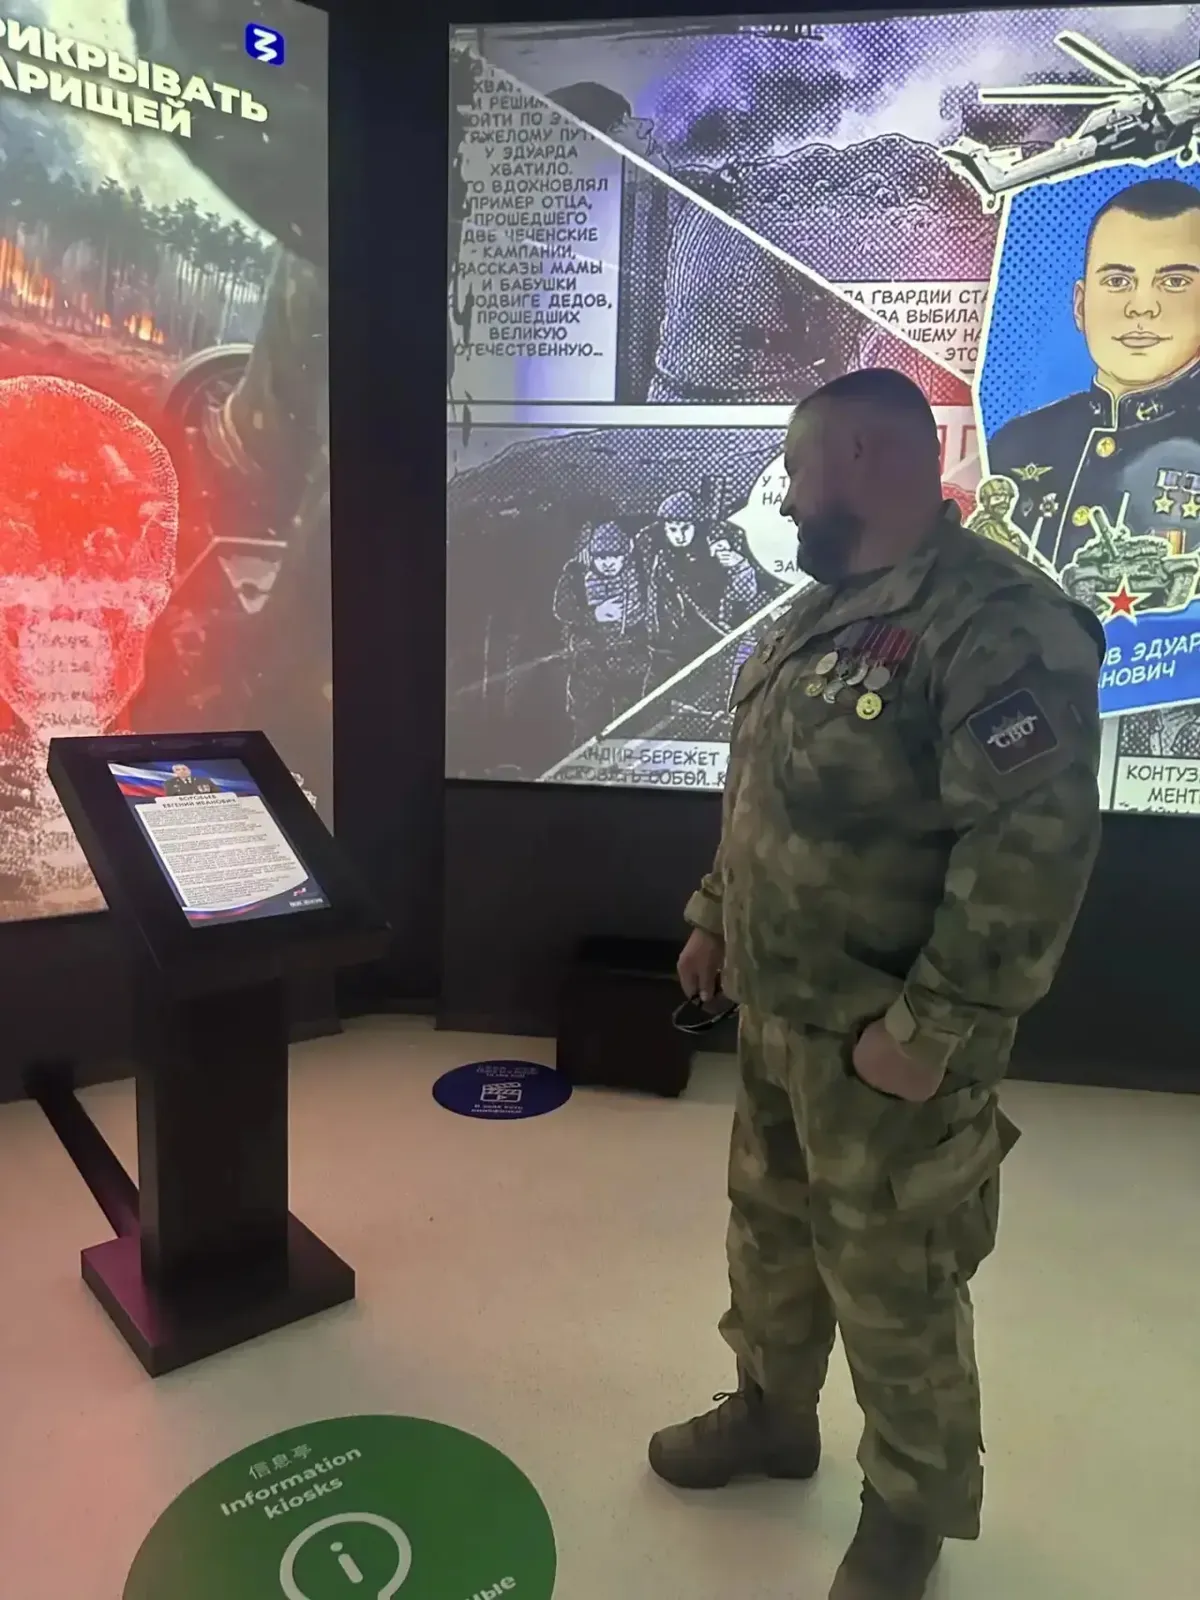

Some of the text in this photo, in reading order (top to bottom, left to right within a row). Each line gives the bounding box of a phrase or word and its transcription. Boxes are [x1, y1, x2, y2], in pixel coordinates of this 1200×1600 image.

[0, 17, 269, 122] ИКРЫВАТЬ
[520, 112, 543, 126] ПО
[463, 128, 596, 143] ЯЖЕЛОМУ ПУТ
[485, 145, 579, 160] У ЭДУАРДА
[490, 162, 574, 176] ХВАТИЛО.
[492, 178, 609, 193] ВДОХНОВЛЯЛ
[470, 195, 593, 210] ПРИМЕР ОТЦА,
[474, 212, 588, 226] ПРОШЕДШЕГО
[463, 228, 598, 244] ДВЕ ЧЕЧЕНСКИЕ
[483, 245, 577, 260] КАМПАНИИ,
[550, 261, 603, 275] МАМЫ
[482, 278, 577, 292] И БАБУШКИ
[548, 294, 613, 309] ДЕДОВ,
[872, 289, 952, 305] ГВАРДИИ
[477, 310, 580, 325] ПРОШЕДШИХ
[906, 309, 979, 324] ВЫБИЛА
[489, 326, 568, 341] ВЕЛИКУЮ
[903, 328, 957, 342] ШЕМУ
[762, 475, 772, 487] У
[1107, 632, 1200, 666] В ЭДУАР
[1101, 659, 1176, 689] НОВИЧ
[1127, 764, 1200, 782] КОНТУЗ
[1148, 786, 1200, 804] МЕНТ
[220, 1448, 362, 1517] Information
[264, 1477, 344, 1520] kiosks
